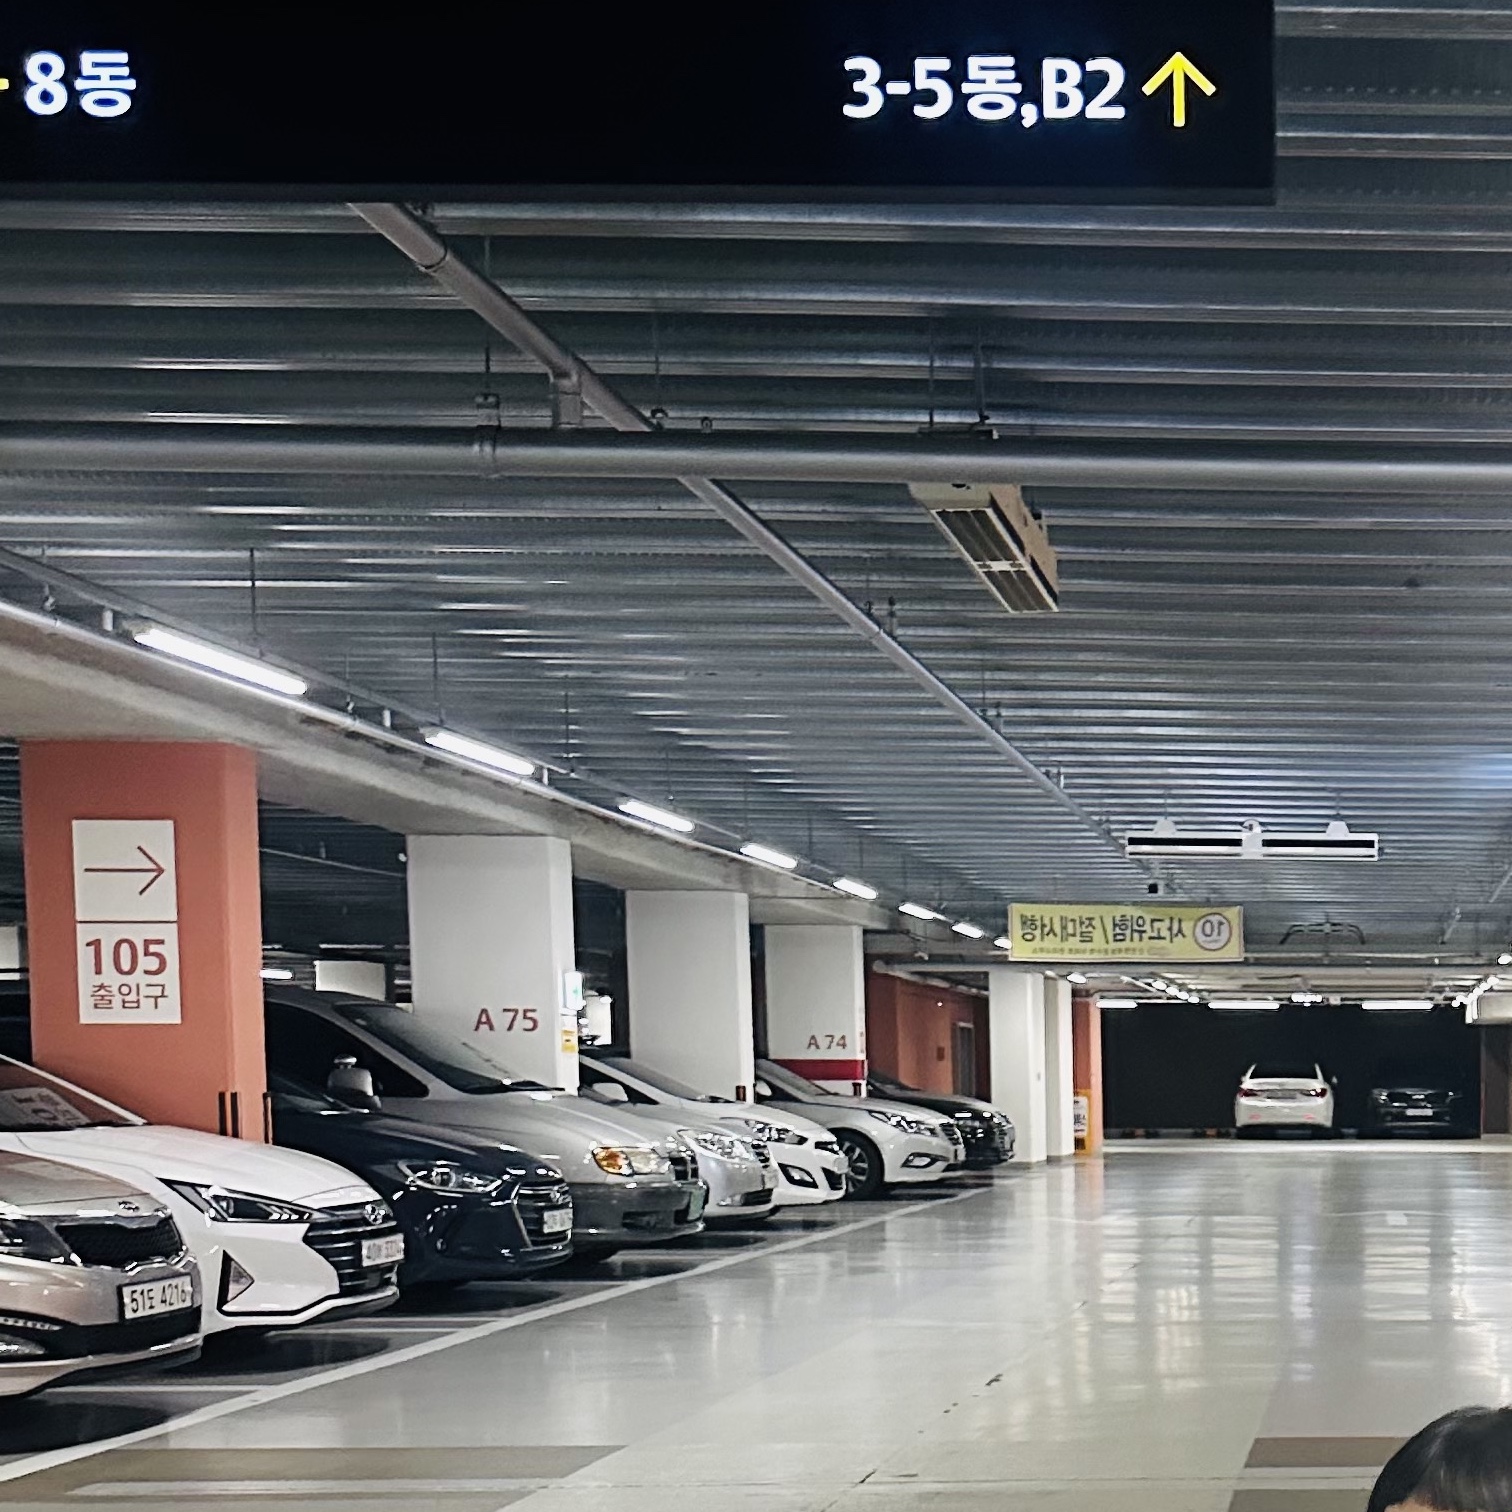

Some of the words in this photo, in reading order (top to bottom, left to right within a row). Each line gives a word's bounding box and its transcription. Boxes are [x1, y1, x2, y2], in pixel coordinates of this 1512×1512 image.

[842, 55, 1126, 129] 3-5동,B2
[85, 938, 167, 976] 105
[90, 982, 169, 1010] 출입구
[473, 1007, 496, 1032] A
[502, 1008, 539, 1032] 75
[807, 1034, 820, 1050] A
[824, 1034, 847, 1050] 74
[161, 1281, 187, 1307] 4216
